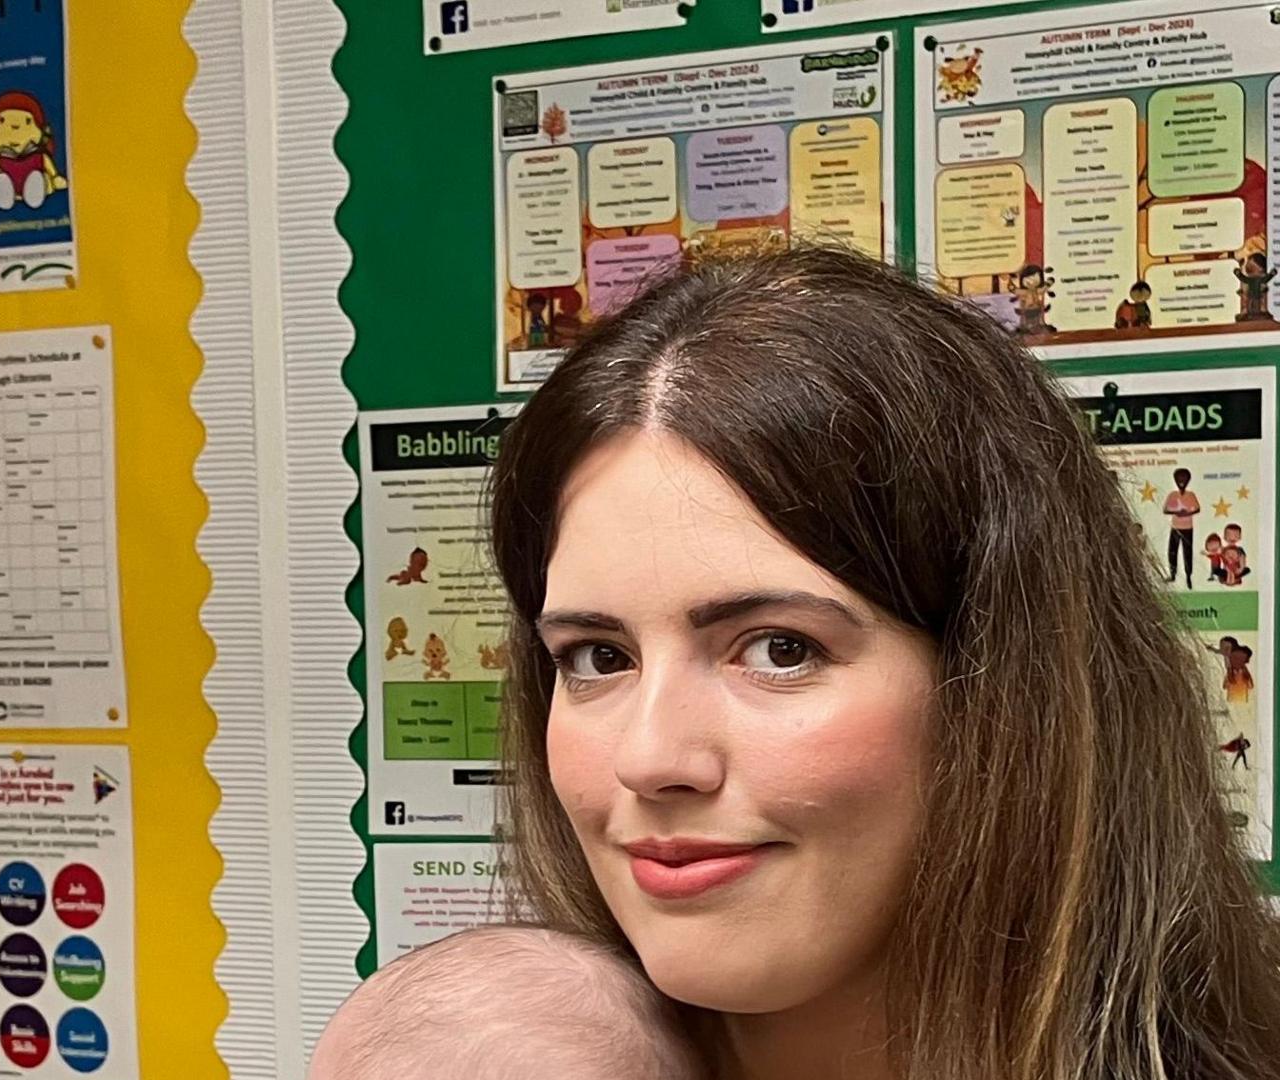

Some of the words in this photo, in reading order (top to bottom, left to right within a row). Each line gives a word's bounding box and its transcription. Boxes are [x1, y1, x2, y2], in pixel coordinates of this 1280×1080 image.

[1041, 33, 1082, 44] AUTUMN
[1085, 29, 1110, 39] TERM
[1118, 25, 1141, 36] (Sept
[1149, 22, 1165, 32] Dec
[1168, 18, 1193, 30] 2024)
[1086, 404, 1223, 434] T-A-DADS
[397, 431, 500, 458] Babbling
[413, 861, 465, 876] SEND
